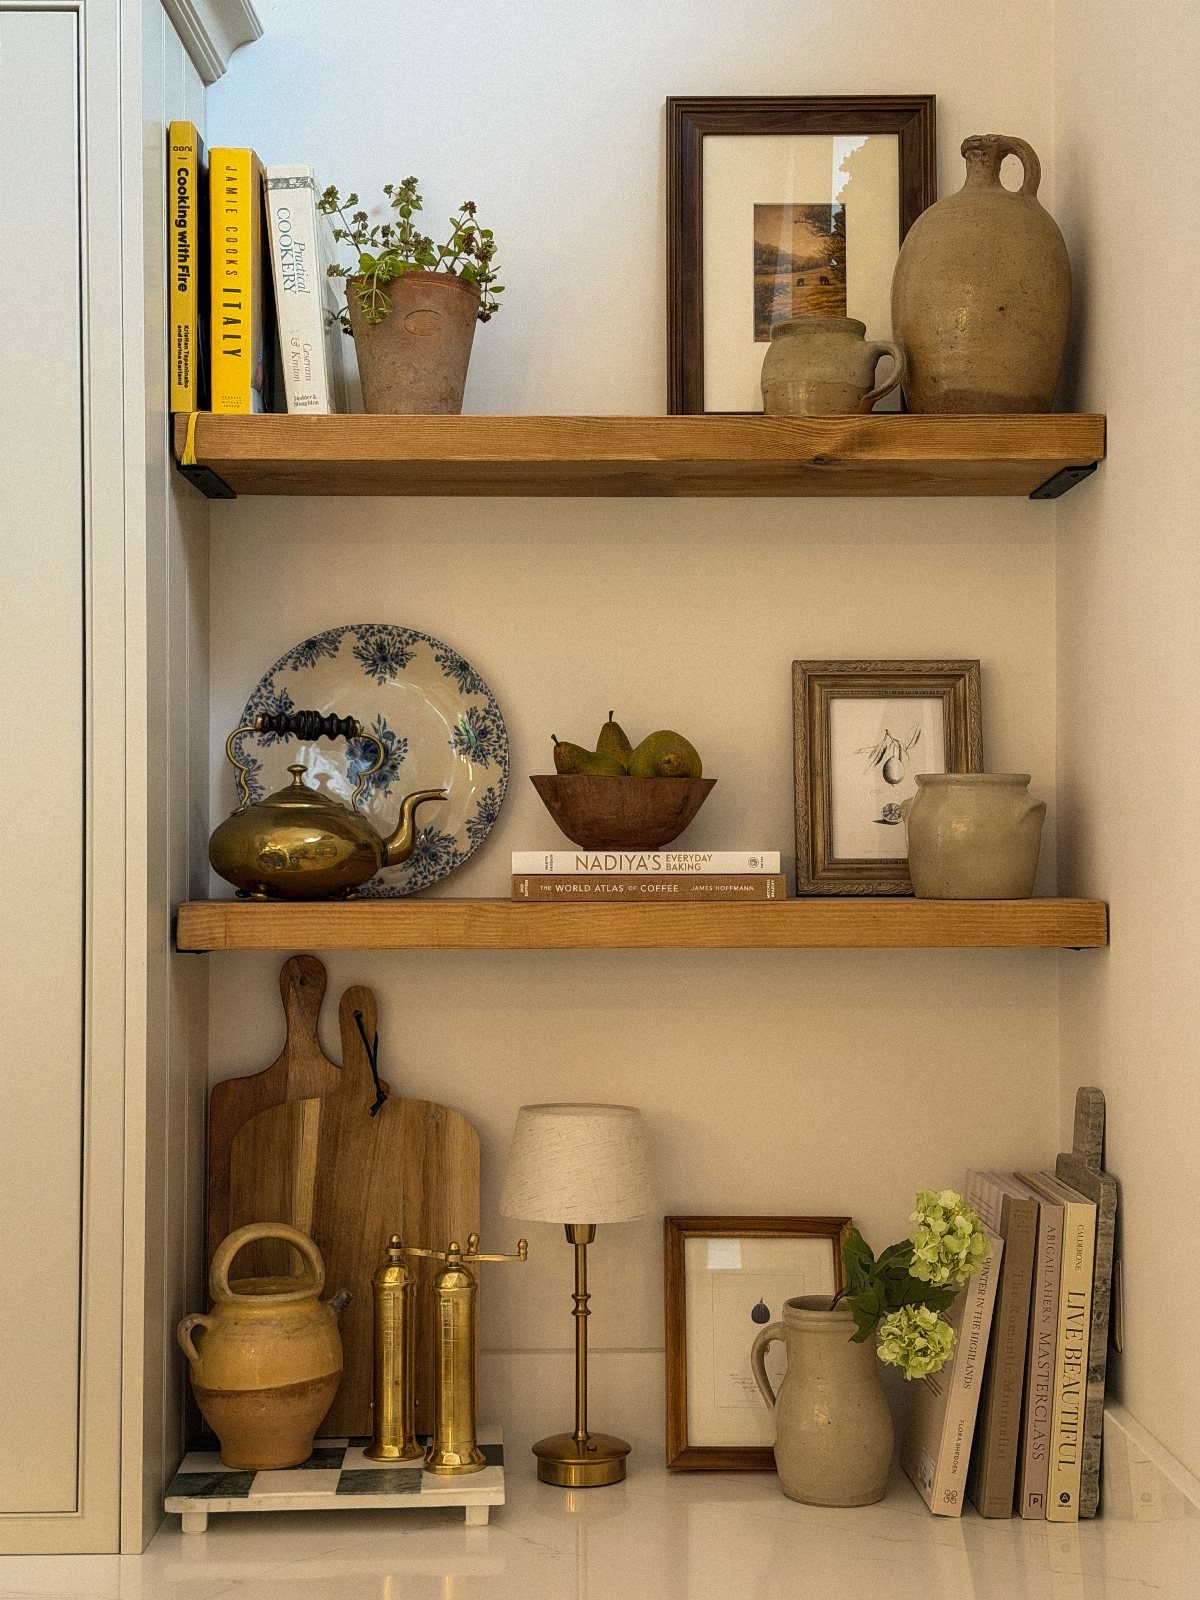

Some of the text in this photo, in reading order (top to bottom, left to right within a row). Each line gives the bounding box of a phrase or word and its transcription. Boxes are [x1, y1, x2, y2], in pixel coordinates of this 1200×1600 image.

[174, 167, 191, 292] Cooking with Fire
[276, 207, 297, 294] COOKERY
[222, 165, 242, 358] JAMIE COOKS ITALY
[293, 241, 311, 294] Practical
[290, 337, 302, 382] & Kinton
[576, 854, 662, 871] NADIYA'S
[666, 854, 713, 863] EVERYDAY
[666, 863, 702, 871] BAKING
[555, 884, 591, 892] WORLD
[594, 884, 624, 892] ATLAS
[640, 884, 679, 893] COFFEE
[1041, 1225, 1056, 1324] ABIGAIL AHERN
[972, 1309, 984, 1330] THE
[975, 1297, 985, 1310] IN
[963, 1330, 980, 1390] HIGHLANDS
[1057, 1291, 1086, 1472] LIVE BEAUTIFUL
[1032, 1332, 1052, 1461] MASTERCLASS
[951, 1419, 965, 1475] FLORA SHEDDEN
